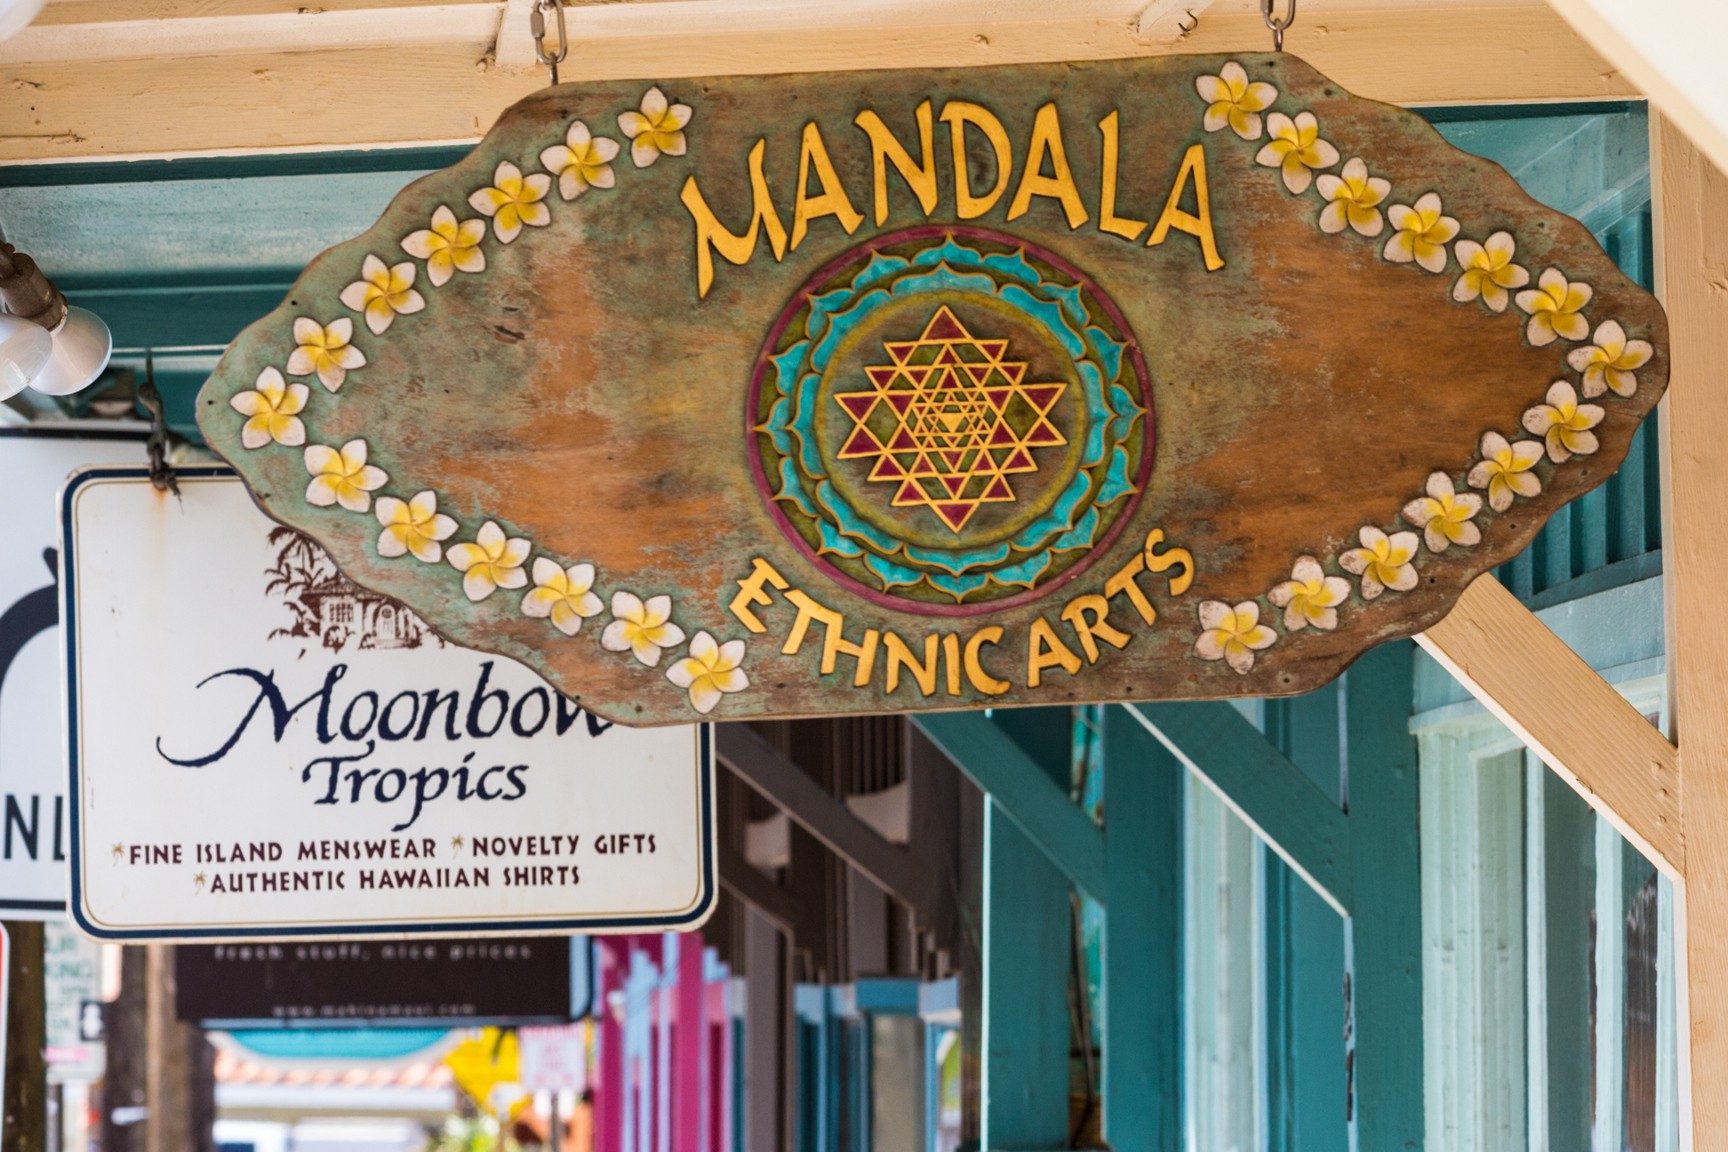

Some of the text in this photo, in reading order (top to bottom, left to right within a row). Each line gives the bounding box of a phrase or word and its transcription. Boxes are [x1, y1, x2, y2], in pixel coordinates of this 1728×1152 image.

[680, 100, 1225, 299] MANDALA
[728, 528, 1195, 697] ETHNIC ARTS
[156, 660, 617, 768] Moonbow
[301, 740, 530, 832] Tropics
[129, 833, 657, 865] FINE ISLAND MENSWEAR NOVELTY GIFTS
[210, 865, 580, 893] AUTHENTIC HAWAIIAN SHIRTS
